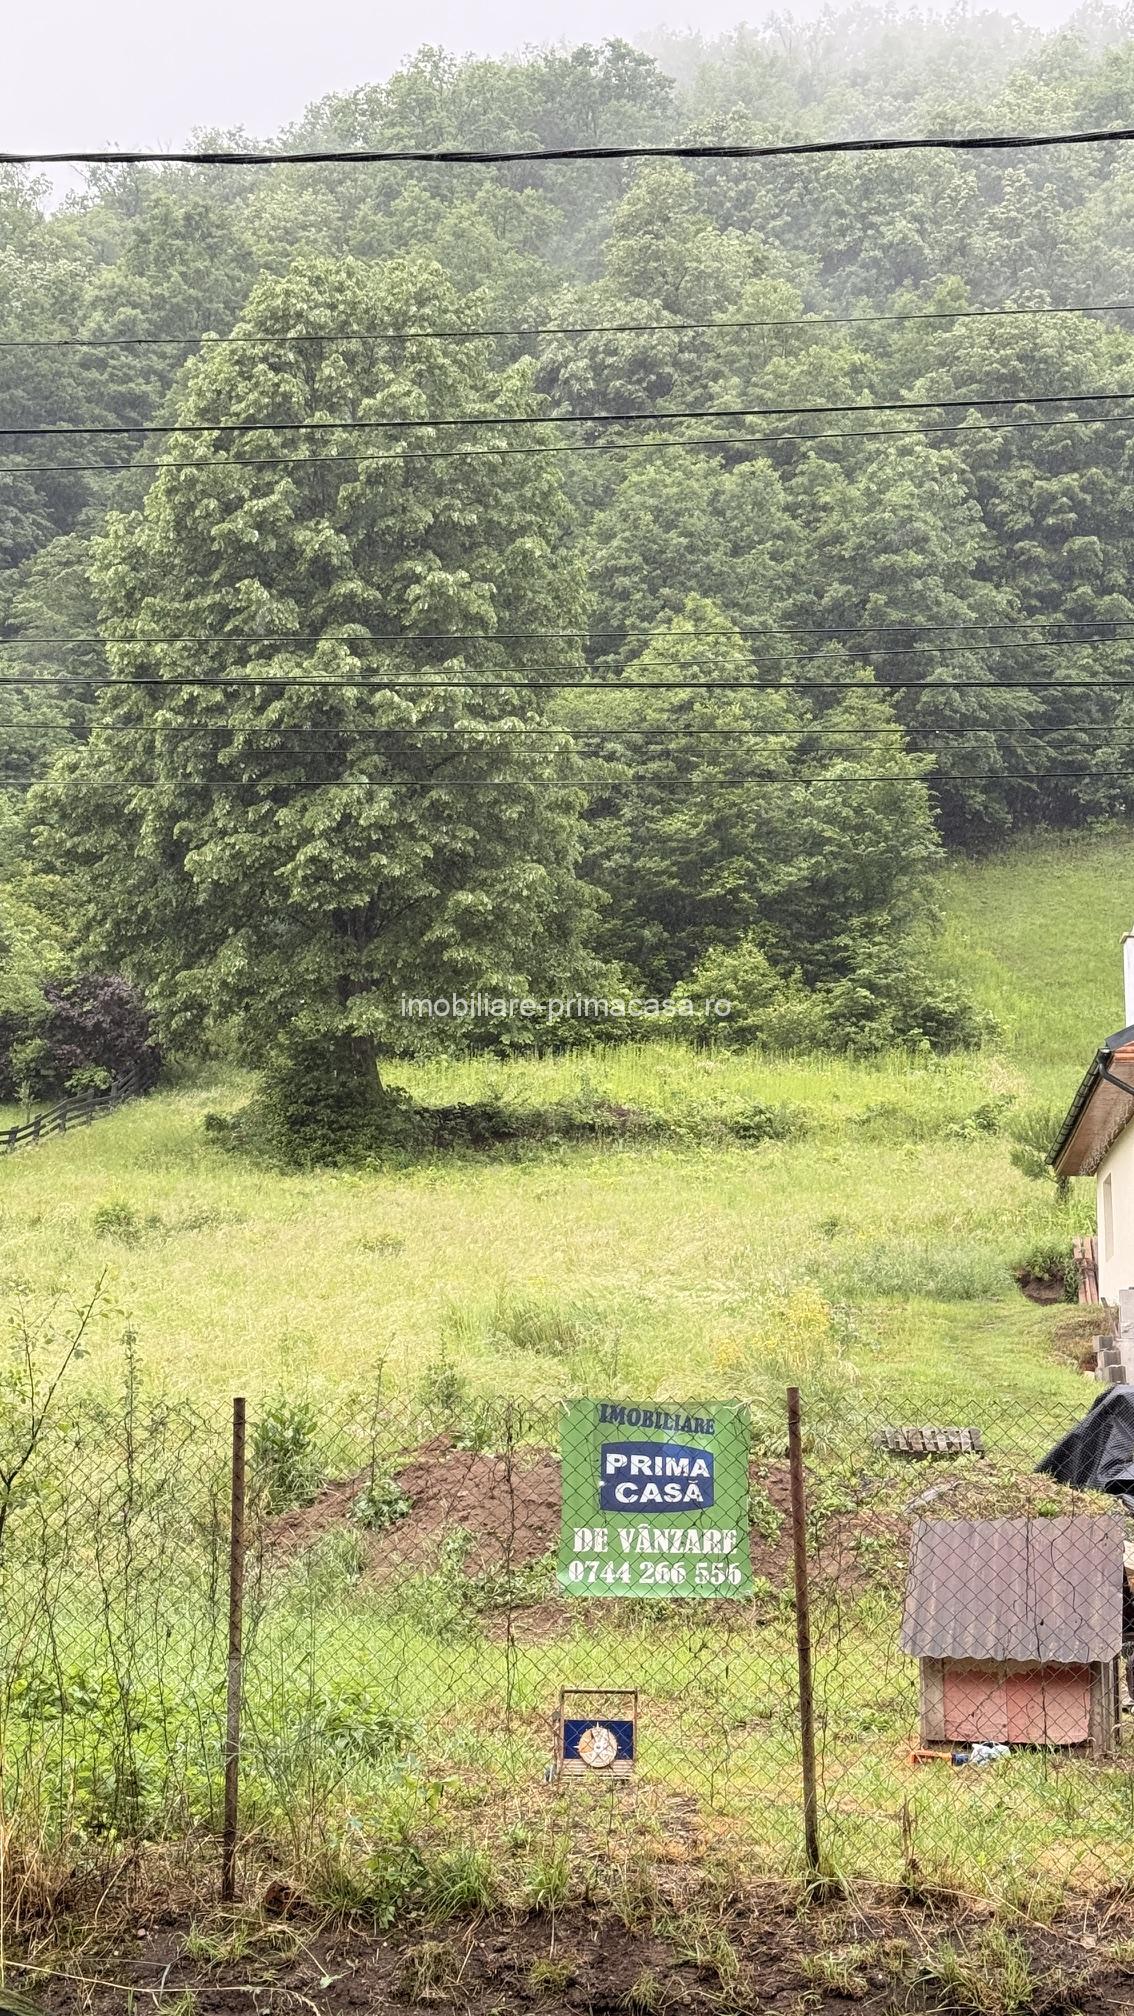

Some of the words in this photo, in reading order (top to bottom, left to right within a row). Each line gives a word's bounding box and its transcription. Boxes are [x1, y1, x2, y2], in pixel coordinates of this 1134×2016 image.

[600, 1404, 716, 1435] IMOBILIARE
[606, 1453, 710, 1478] PRIMA
[614, 1480, 704, 1503] CASĂ
[573, 1527, 608, 1553] DE
[617, 1524, 738, 1554] VÂNZARE
[568, 1560, 631, 1584] 0744
[639, 1561, 686, 1584] 266
[695, 1563, 742, 1585] 556
